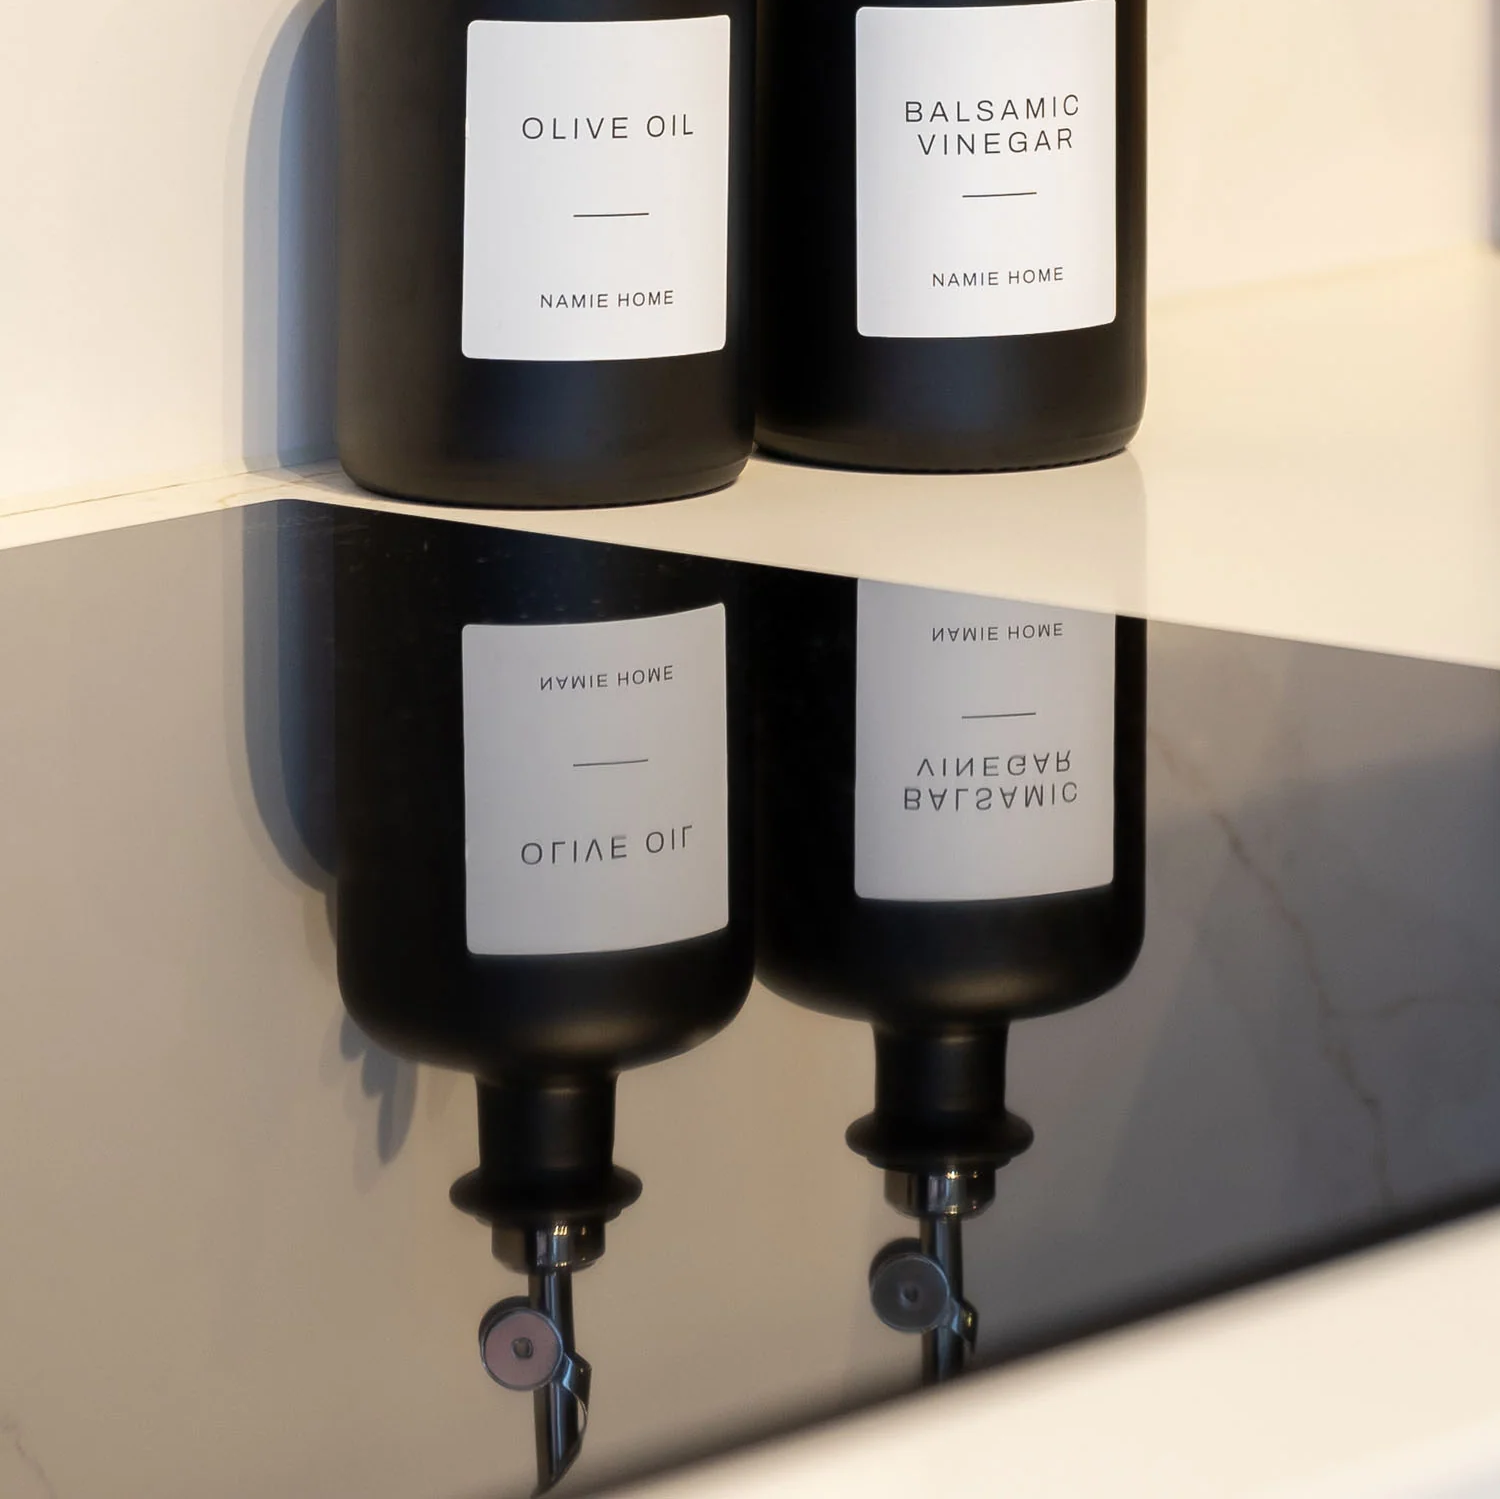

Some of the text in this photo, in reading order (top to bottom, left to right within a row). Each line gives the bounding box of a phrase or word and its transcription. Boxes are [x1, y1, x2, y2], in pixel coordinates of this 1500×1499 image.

[905, 93, 1079, 123] BALSAMIC
[521, 113, 694, 140] OLIVE OIL
[916, 127, 1073, 156] VINEGAR
[932, 266, 1064, 288] NAMIE HOME
[540, 289, 674, 309] NAMIE HOME
